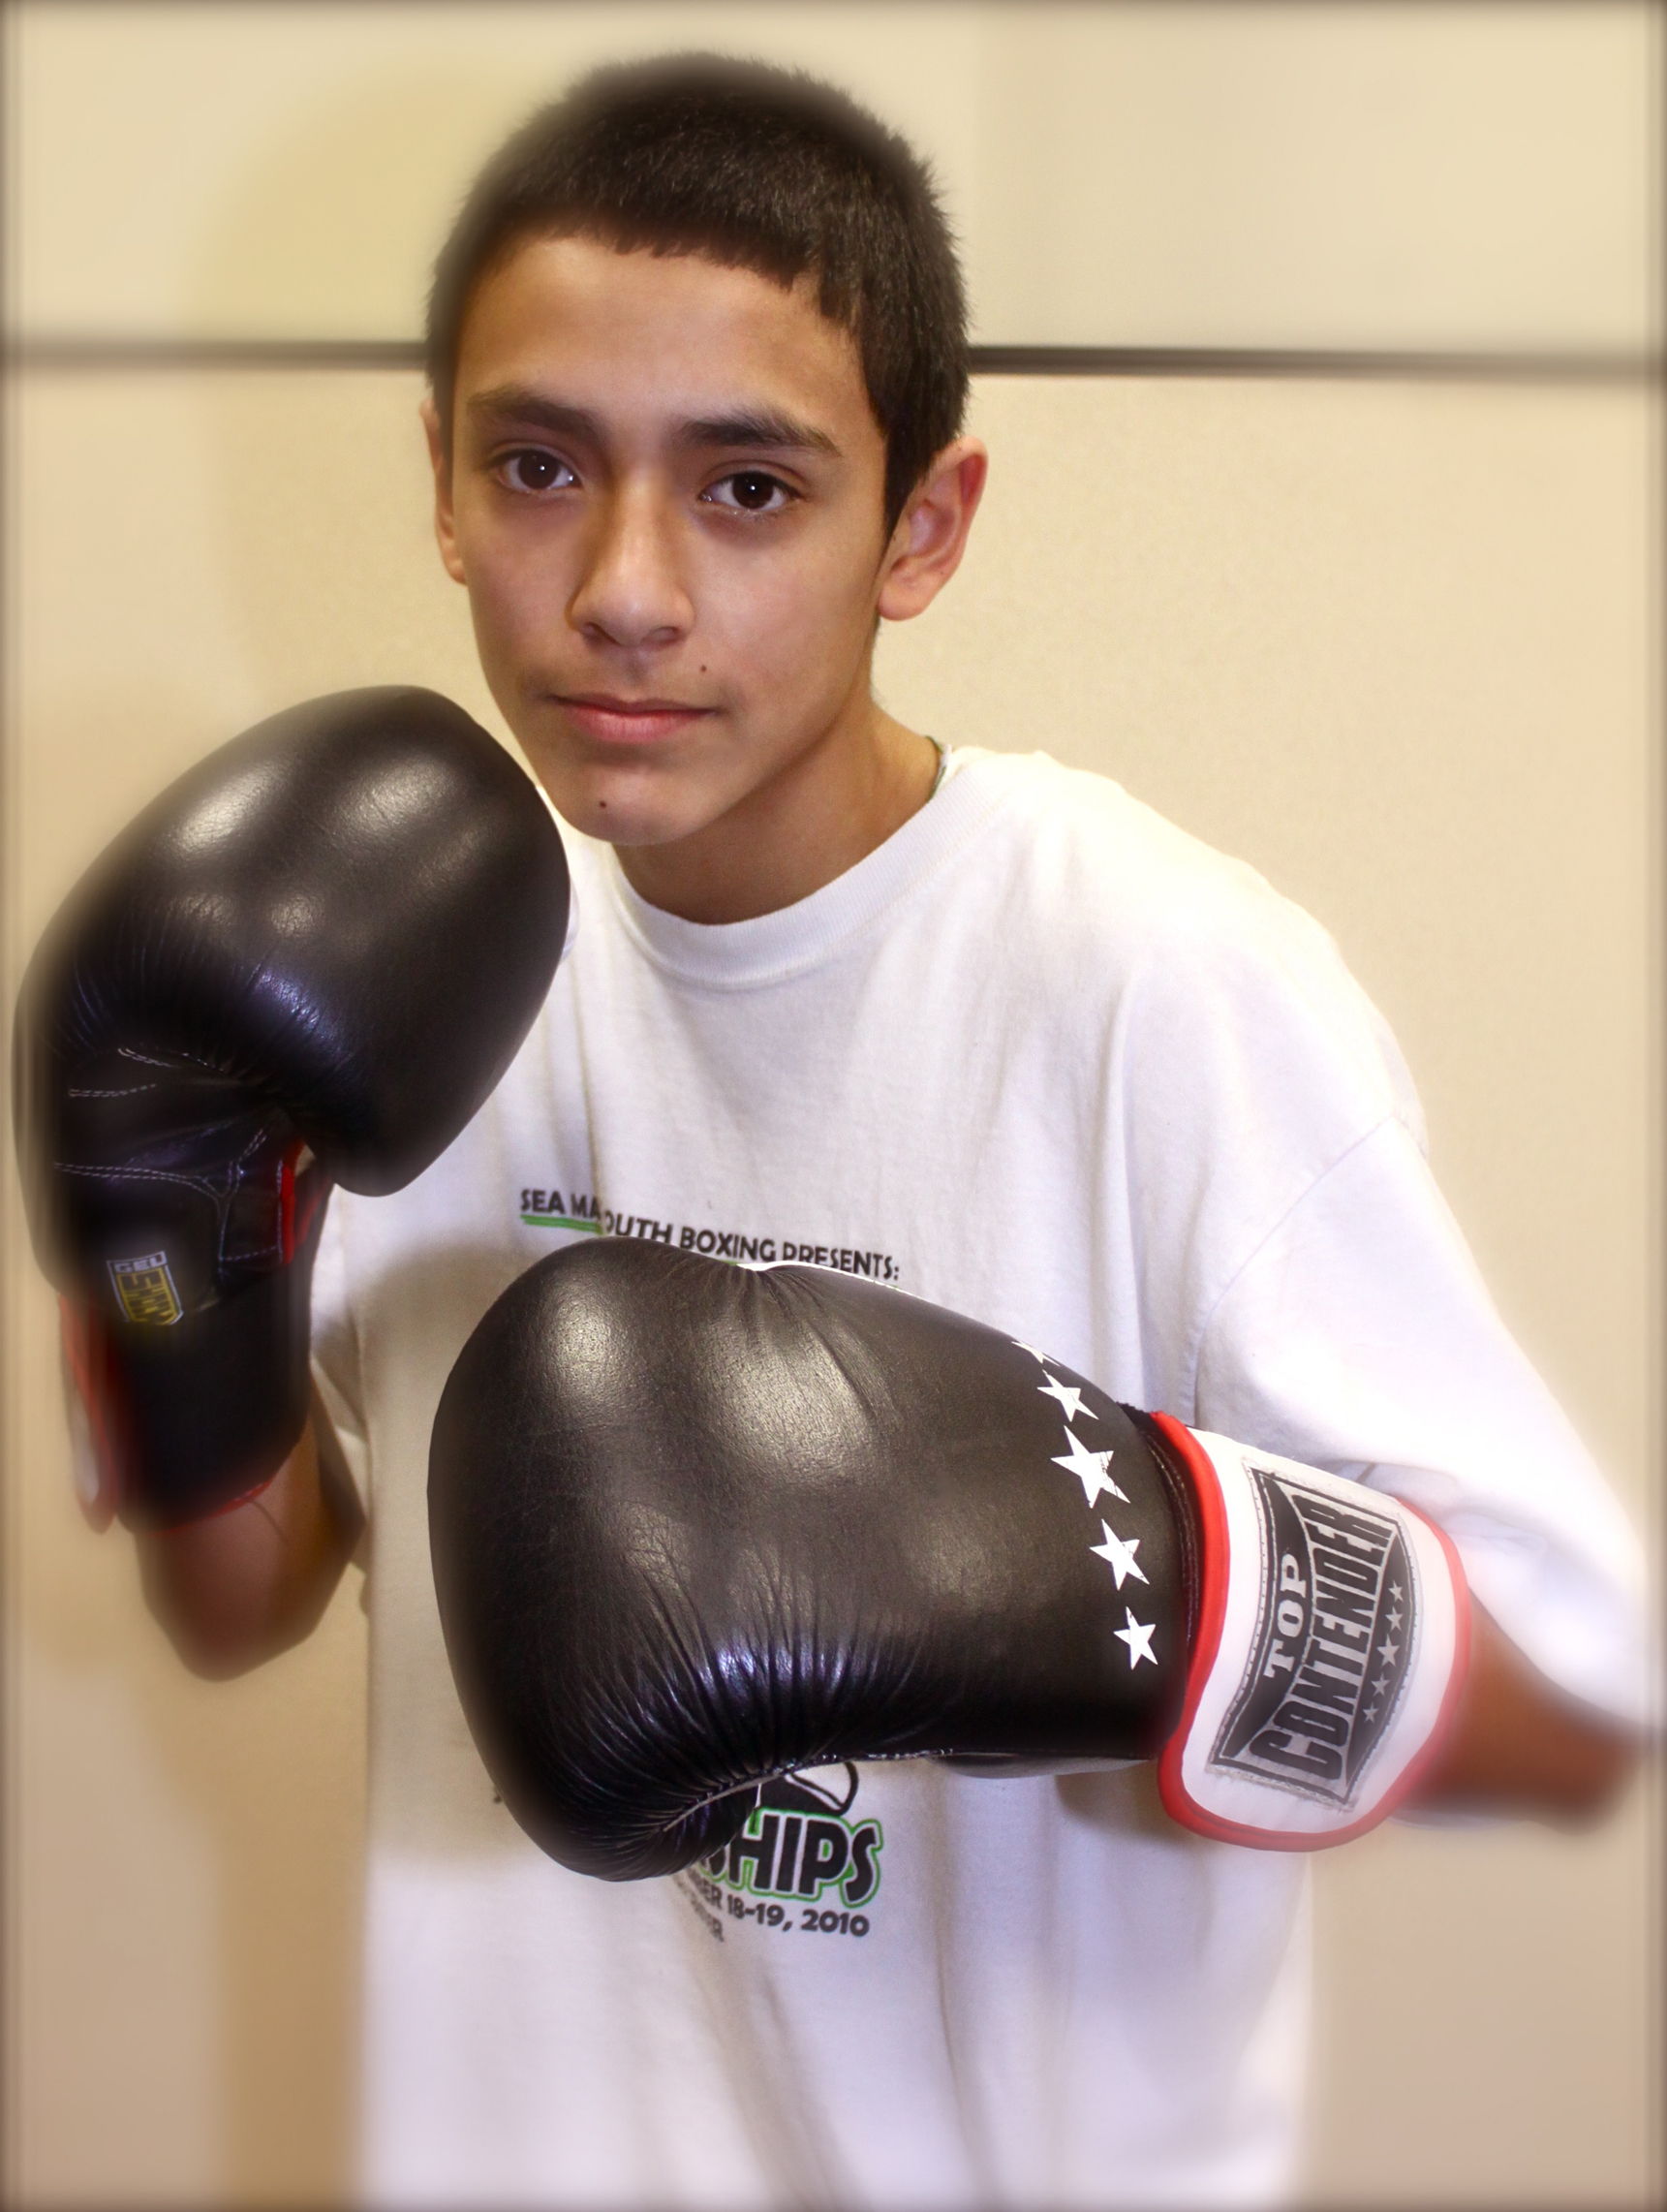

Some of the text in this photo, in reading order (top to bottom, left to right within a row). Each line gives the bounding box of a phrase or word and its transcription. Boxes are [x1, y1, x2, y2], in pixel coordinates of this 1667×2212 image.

[520, 1189, 566, 1214] SEA
[680, 1227, 775, 1262] BOXING
[783, 1241, 900, 1281] PRESENTS:
[1249, 1494, 1393, 1781] CONTENDER
[1263, 1553, 1308, 1678] TOP
[727, 1892, 792, 1932] 18-19,
[801, 1908, 870, 1937] 2010
